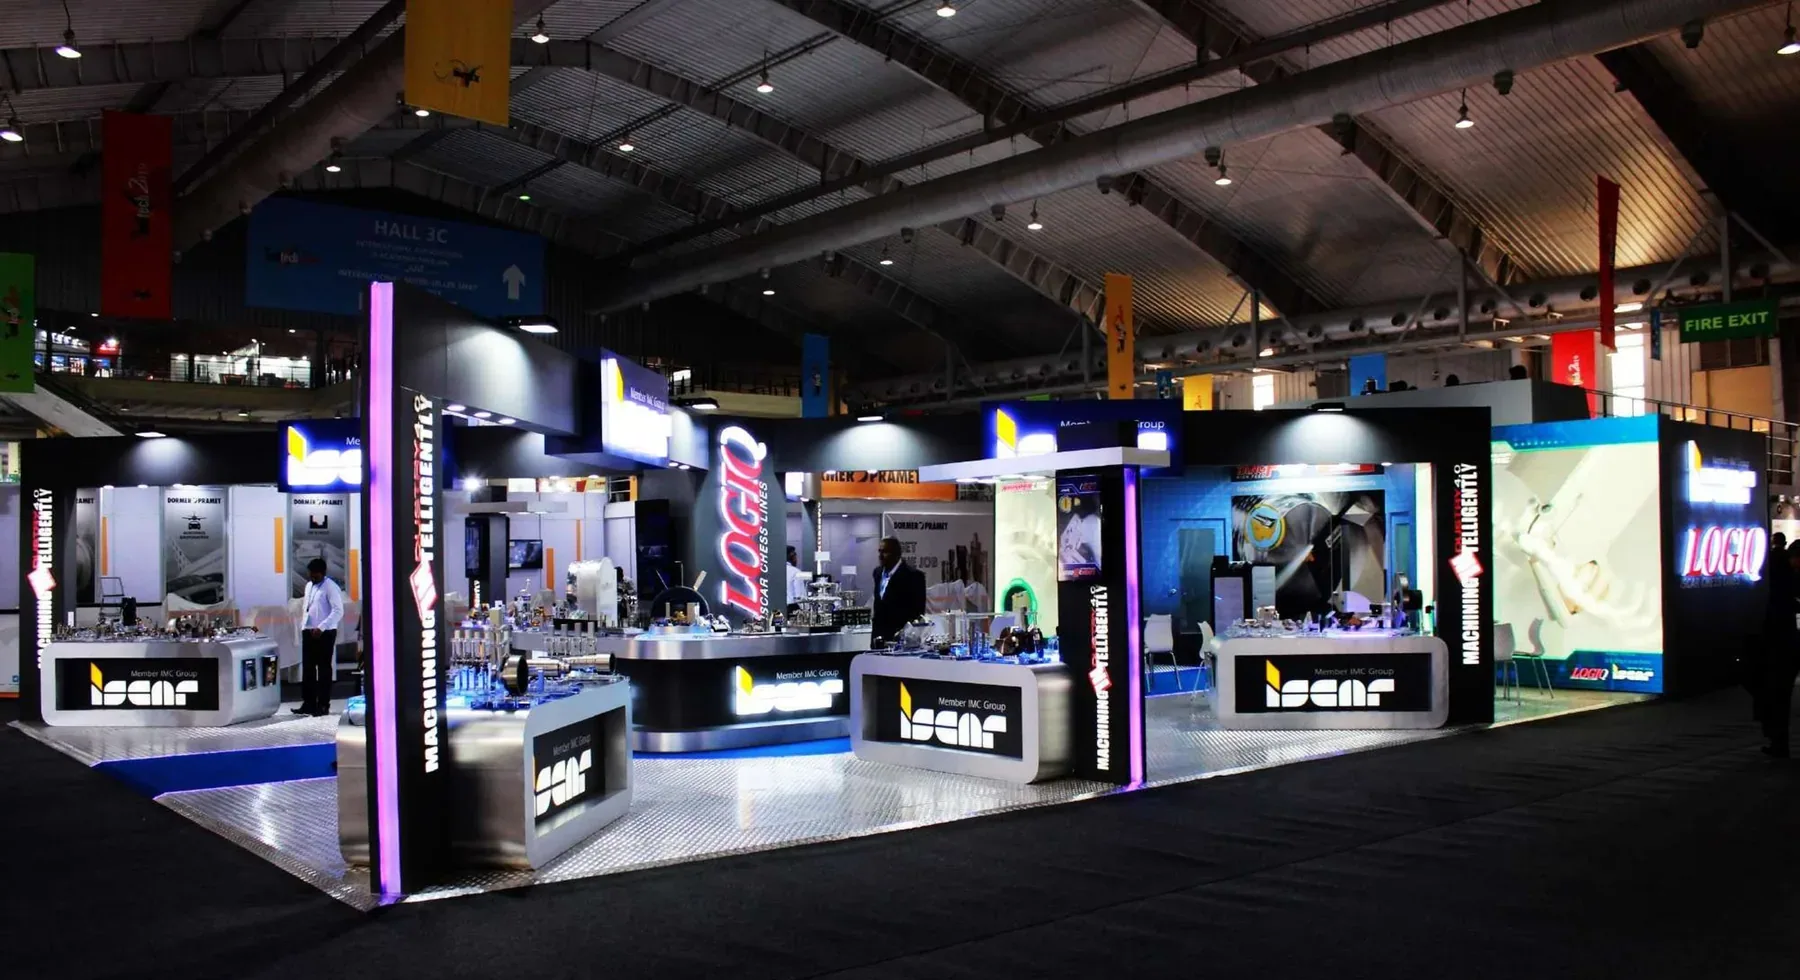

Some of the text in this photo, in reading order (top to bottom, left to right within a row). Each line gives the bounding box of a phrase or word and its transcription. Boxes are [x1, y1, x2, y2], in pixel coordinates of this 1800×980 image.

[374, 219, 449, 244] HALL 3C
[1684, 311, 1769, 332] FIRE EXIT
[758, 482, 768, 523] LINES
[720, 426, 767, 620] LOGIQ
[759, 526, 768, 573] CHESS
[919, 556, 939, 568] JOB
[1682, 526, 1766, 581] LOGIQ
[1462, 577, 1480, 665] MACHINING
[175, 670, 198, 679] Group
[776, 669, 840, 680] Member IMC Group
[1314, 668, 1348, 676] Member
[1368, 668, 1395, 676] Group
[422, 610, 439, 773] MACHINING
[938, 697, 1007, 713] Member IMC Group
[1096, 690, 1110, 771] MACHINING
